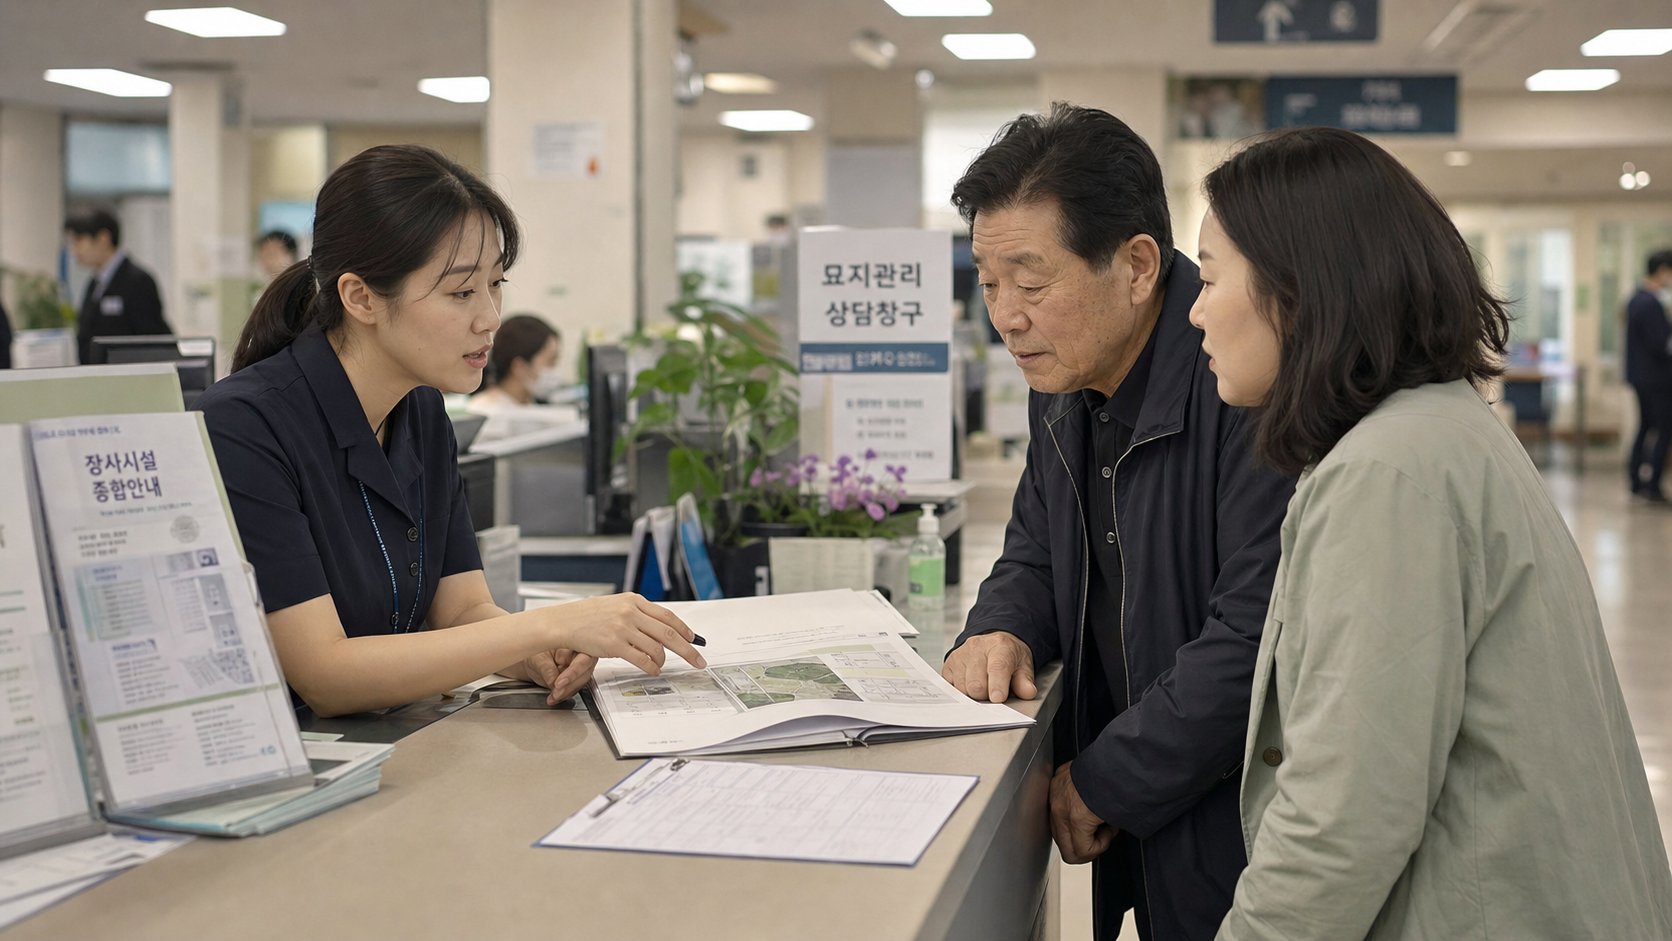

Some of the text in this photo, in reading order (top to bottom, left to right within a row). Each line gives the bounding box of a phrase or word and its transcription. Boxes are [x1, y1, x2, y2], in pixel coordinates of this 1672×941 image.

[822, 263, 921, 288] 묘지관리
[825, 301, 923, 327] 상담창구
[84, 450, 158, 475] 장사시설
[92, 478, 162, 502] 종합안내
